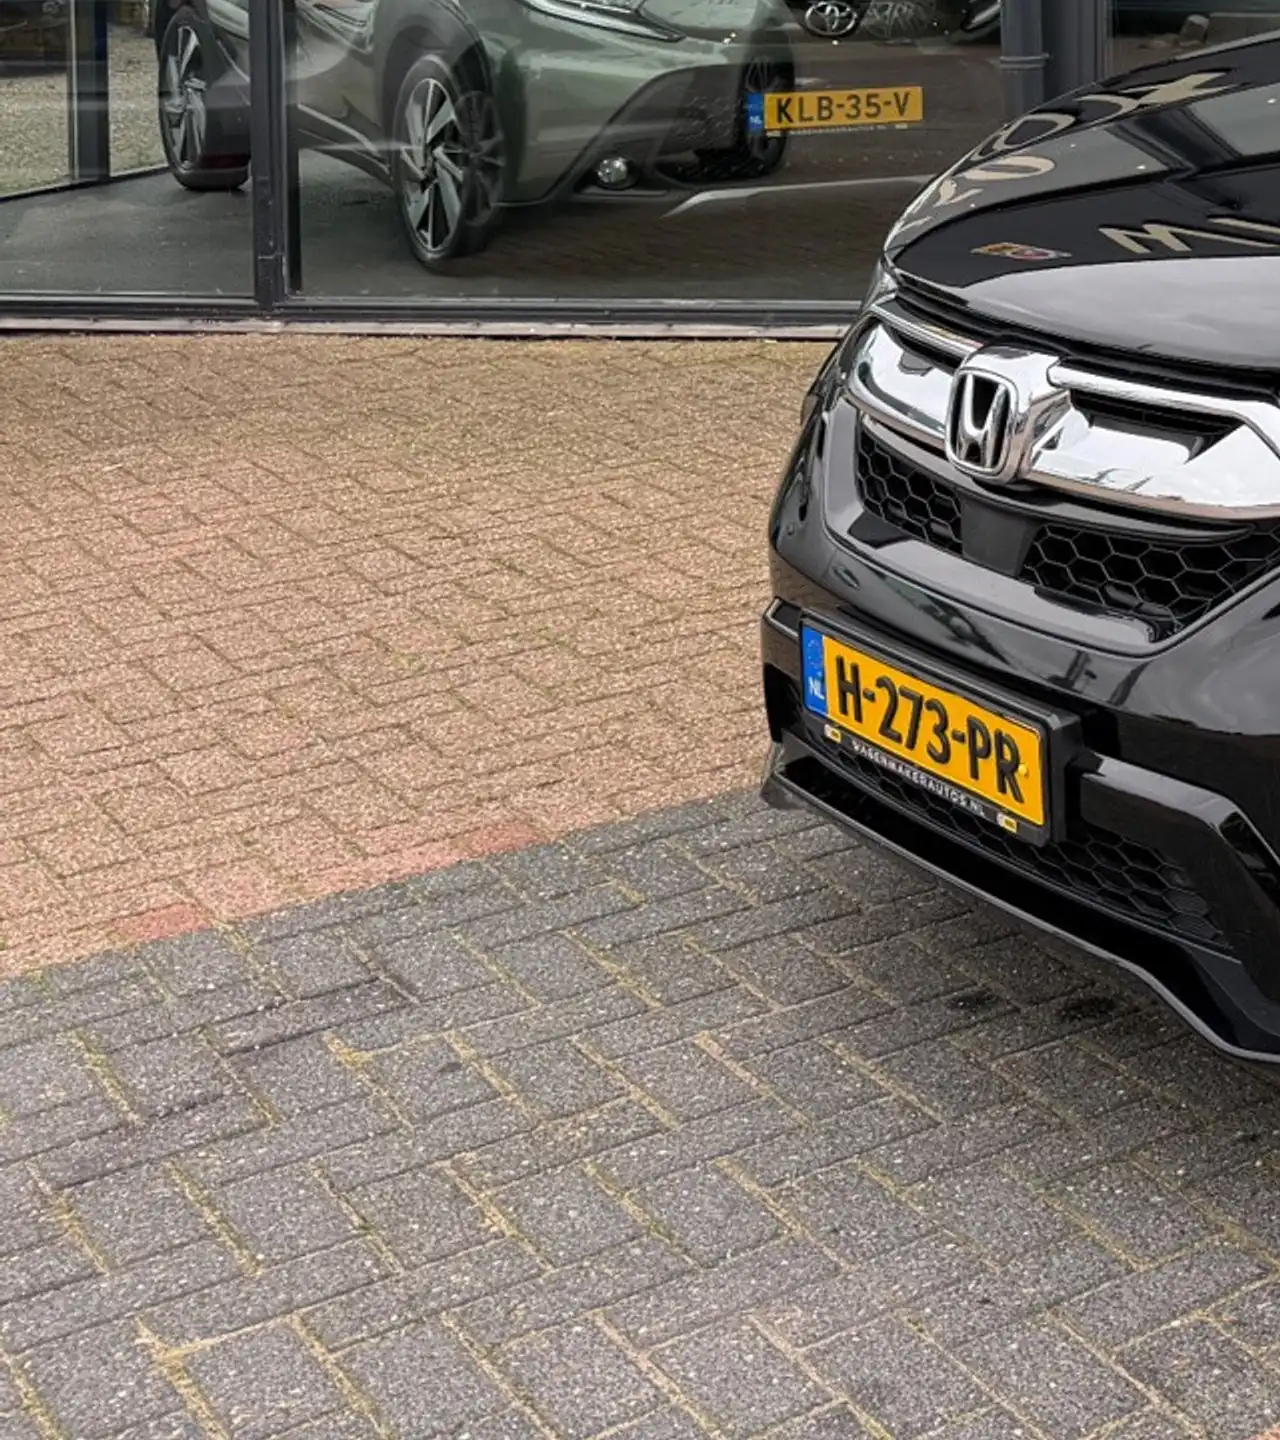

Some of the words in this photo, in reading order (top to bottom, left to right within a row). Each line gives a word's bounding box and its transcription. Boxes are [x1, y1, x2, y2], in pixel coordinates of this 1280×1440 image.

[776, 92, 911, 124] KLB-35-V
[808, 677, 825, 701] NL
[836, 655, 1025, 804] H-273-PR
